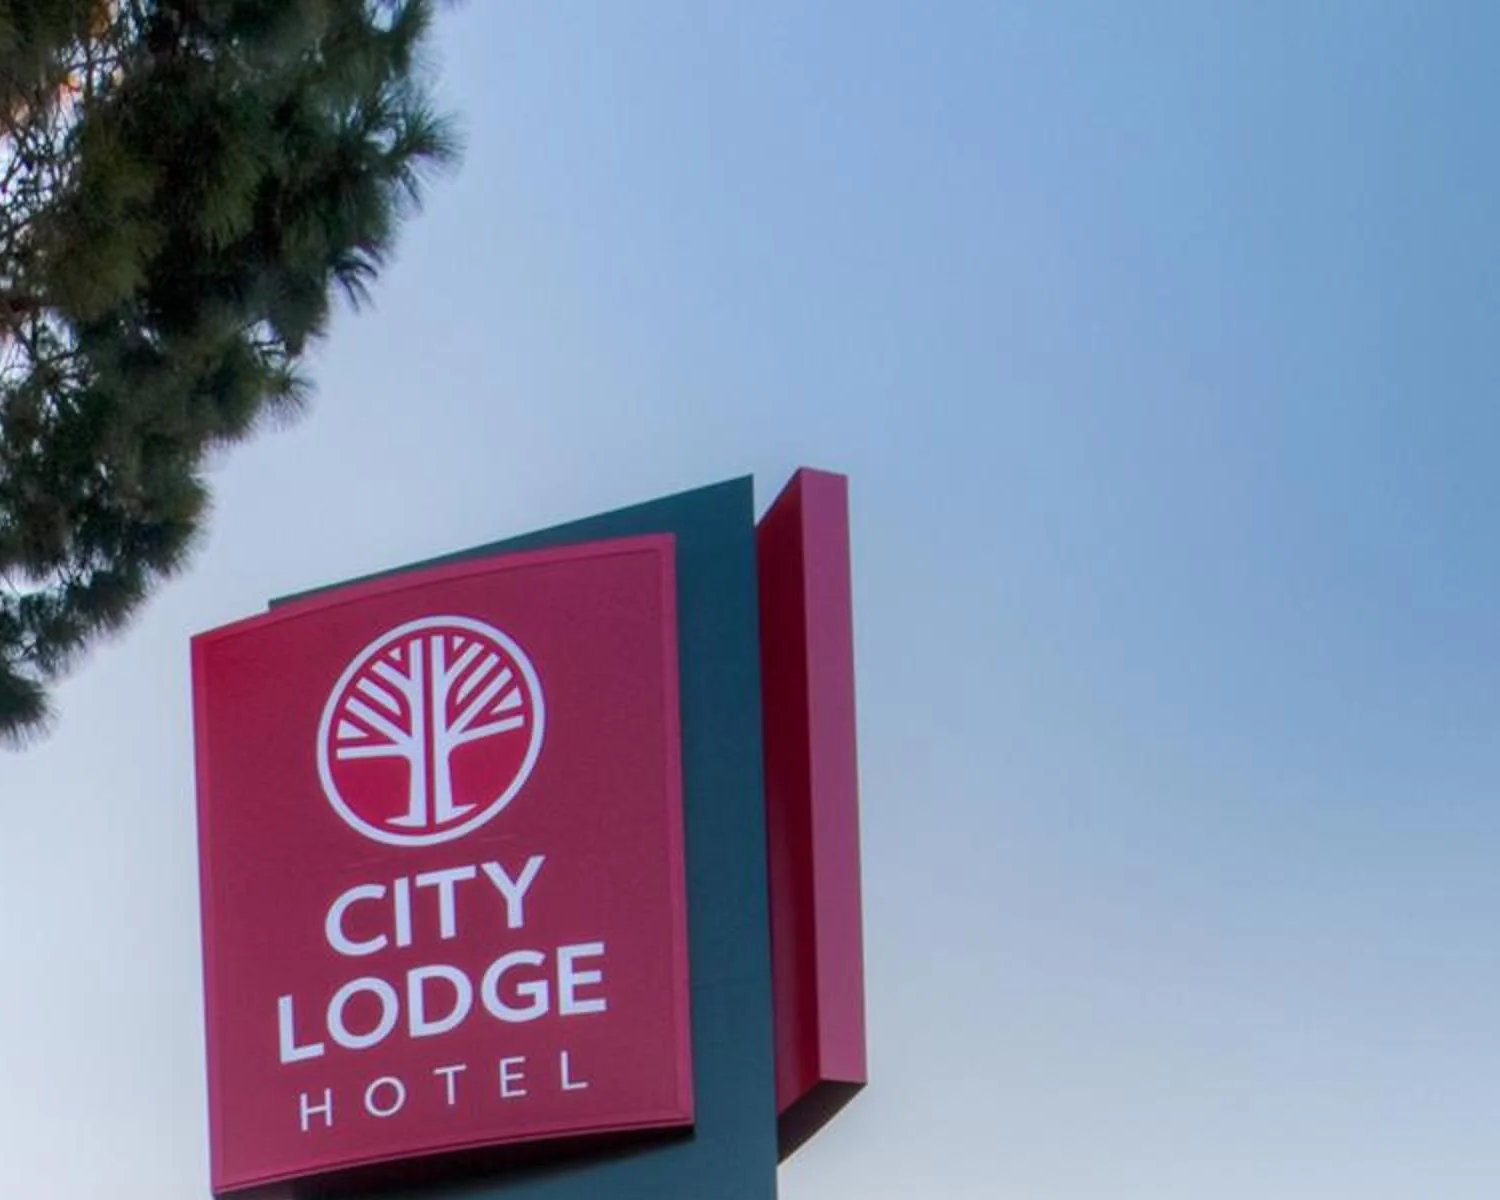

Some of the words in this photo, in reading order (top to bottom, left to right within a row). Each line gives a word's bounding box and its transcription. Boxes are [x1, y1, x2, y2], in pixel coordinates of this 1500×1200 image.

[324, 854, 546, 957] CITY
[277, 942, 608, 1064] LODGE
[299, 1051, 588, 1132] HOTEL
